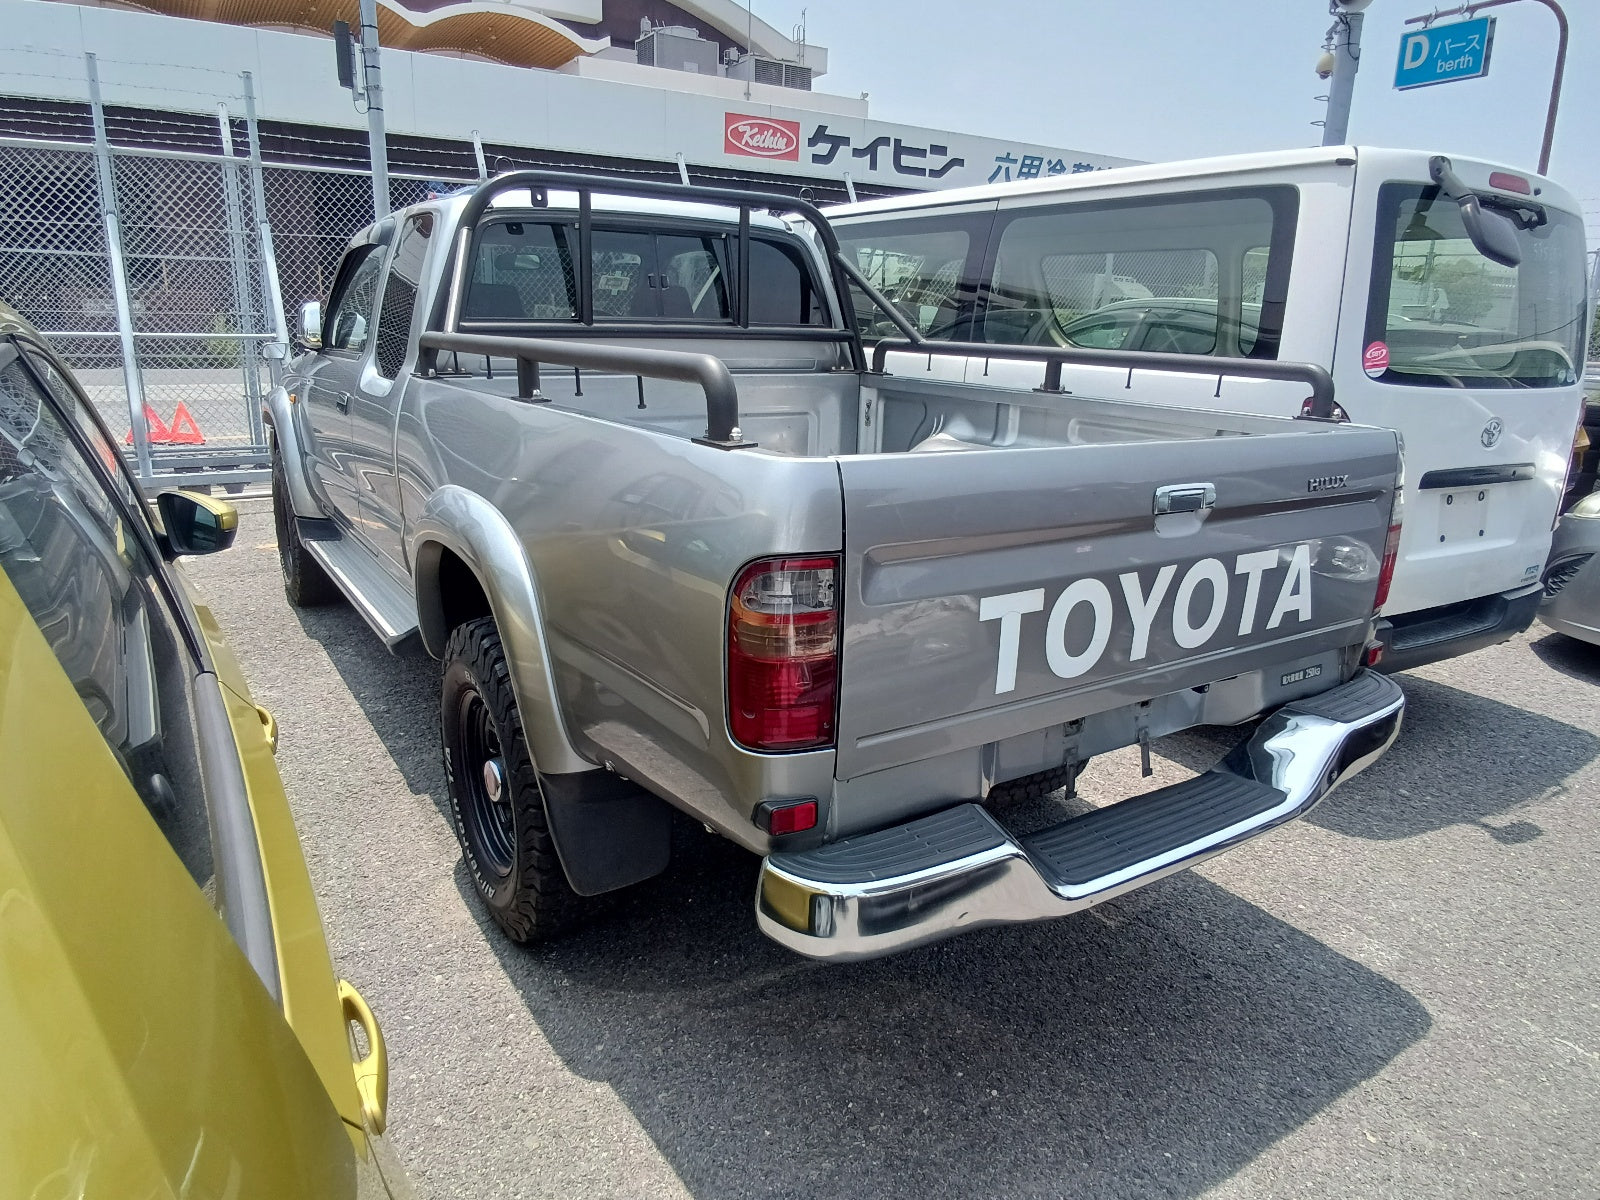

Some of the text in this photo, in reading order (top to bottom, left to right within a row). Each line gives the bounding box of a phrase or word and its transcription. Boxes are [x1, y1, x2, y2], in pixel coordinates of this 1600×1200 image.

[1403, 35, 1430, 70] D
[1433, 34, 1481, 58] バース
[1436, 53, 1473, 73] berth
[738, 125, 788, 151] Keihin
[807, 124, 965, 178] ケイヒン
[1308, 474, 1349, 492] HILUX
[979, 544, 1313, 694] TOYOTA
